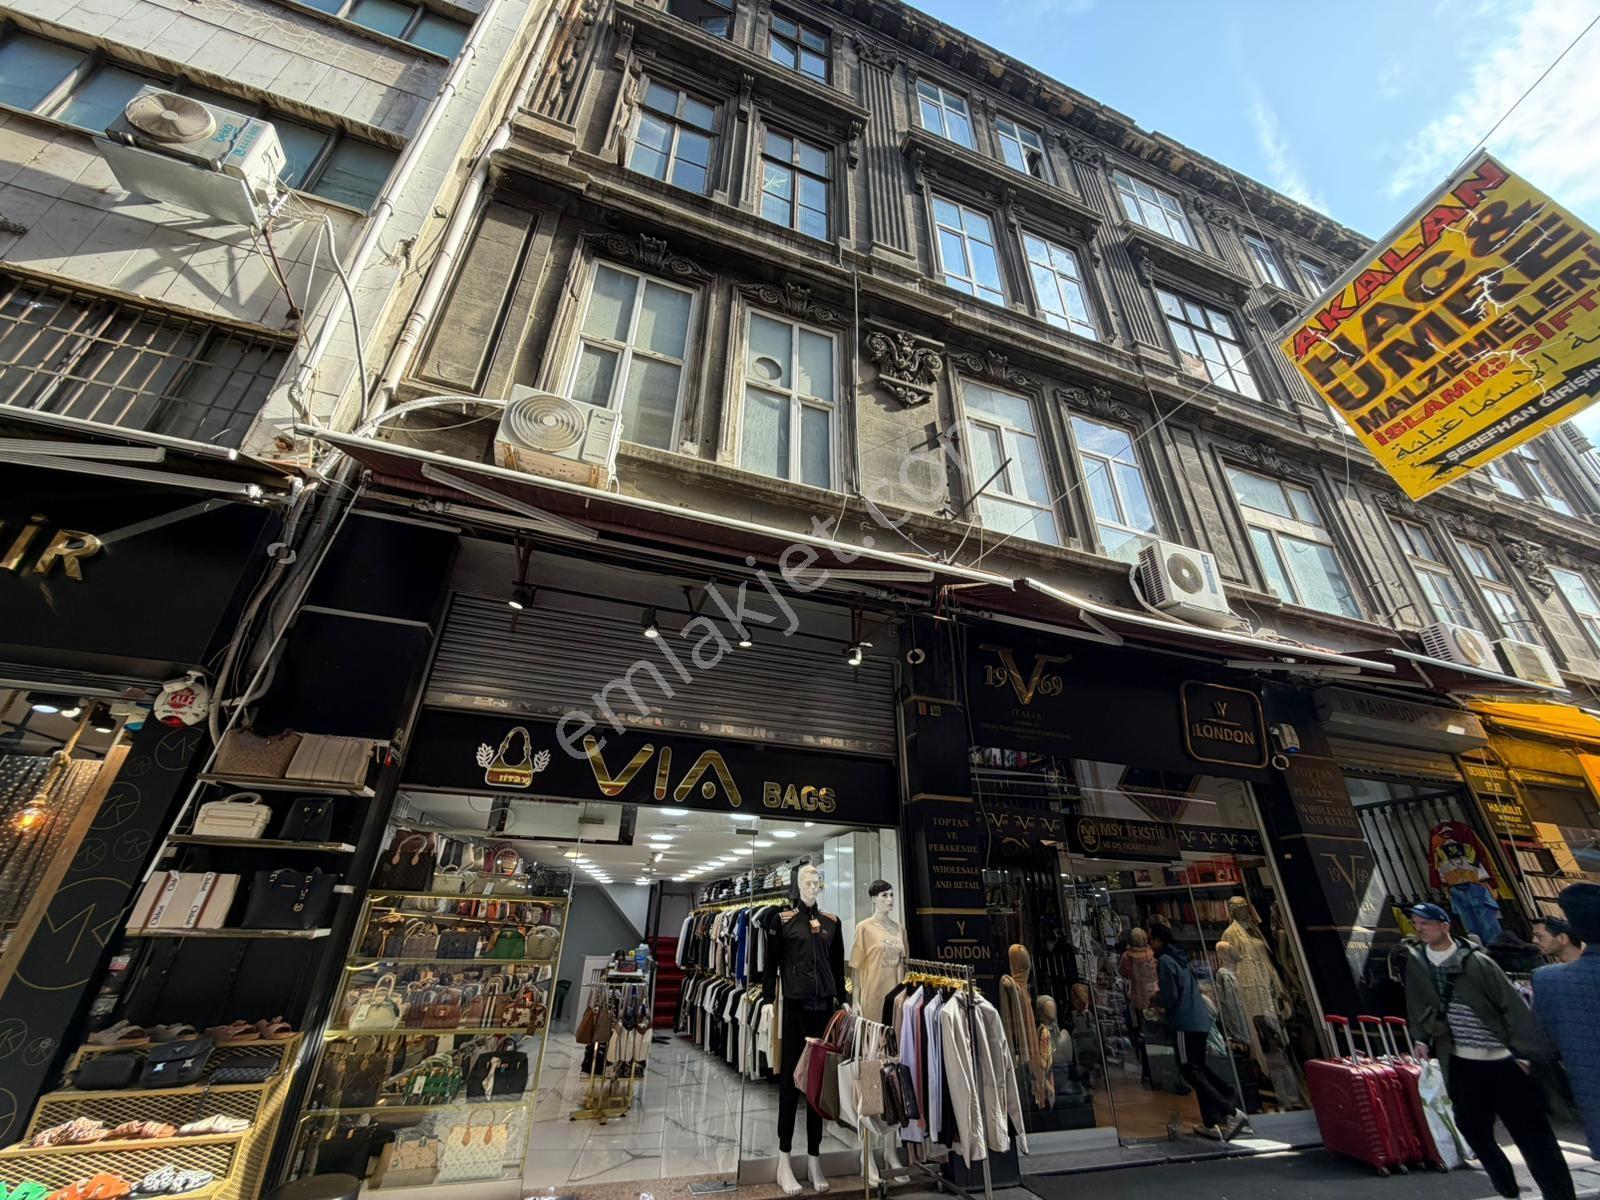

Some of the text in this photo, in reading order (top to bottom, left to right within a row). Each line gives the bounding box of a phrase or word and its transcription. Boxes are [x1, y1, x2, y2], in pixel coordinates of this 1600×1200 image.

[1292, 158, 1511, 362] AKALAN
[1302, 199, 1549, 390] HAC &
[1325, 211, 1592, 412] UMRE
[1512, 283, 1600, 357] GİFT
[0, 513, 102, 580] İR
[1192, 723, 1255, 745] LONDON
[583, 735, 742, 808] VIA
[763, 781, 836, 813] BAGS
[931, 816, 969, 828] TOPTAN
[932, 864, 981, 875] WHOLESALE
[935, 880, 953, 890] AND
[936, 945, 991, 960] LONDON
